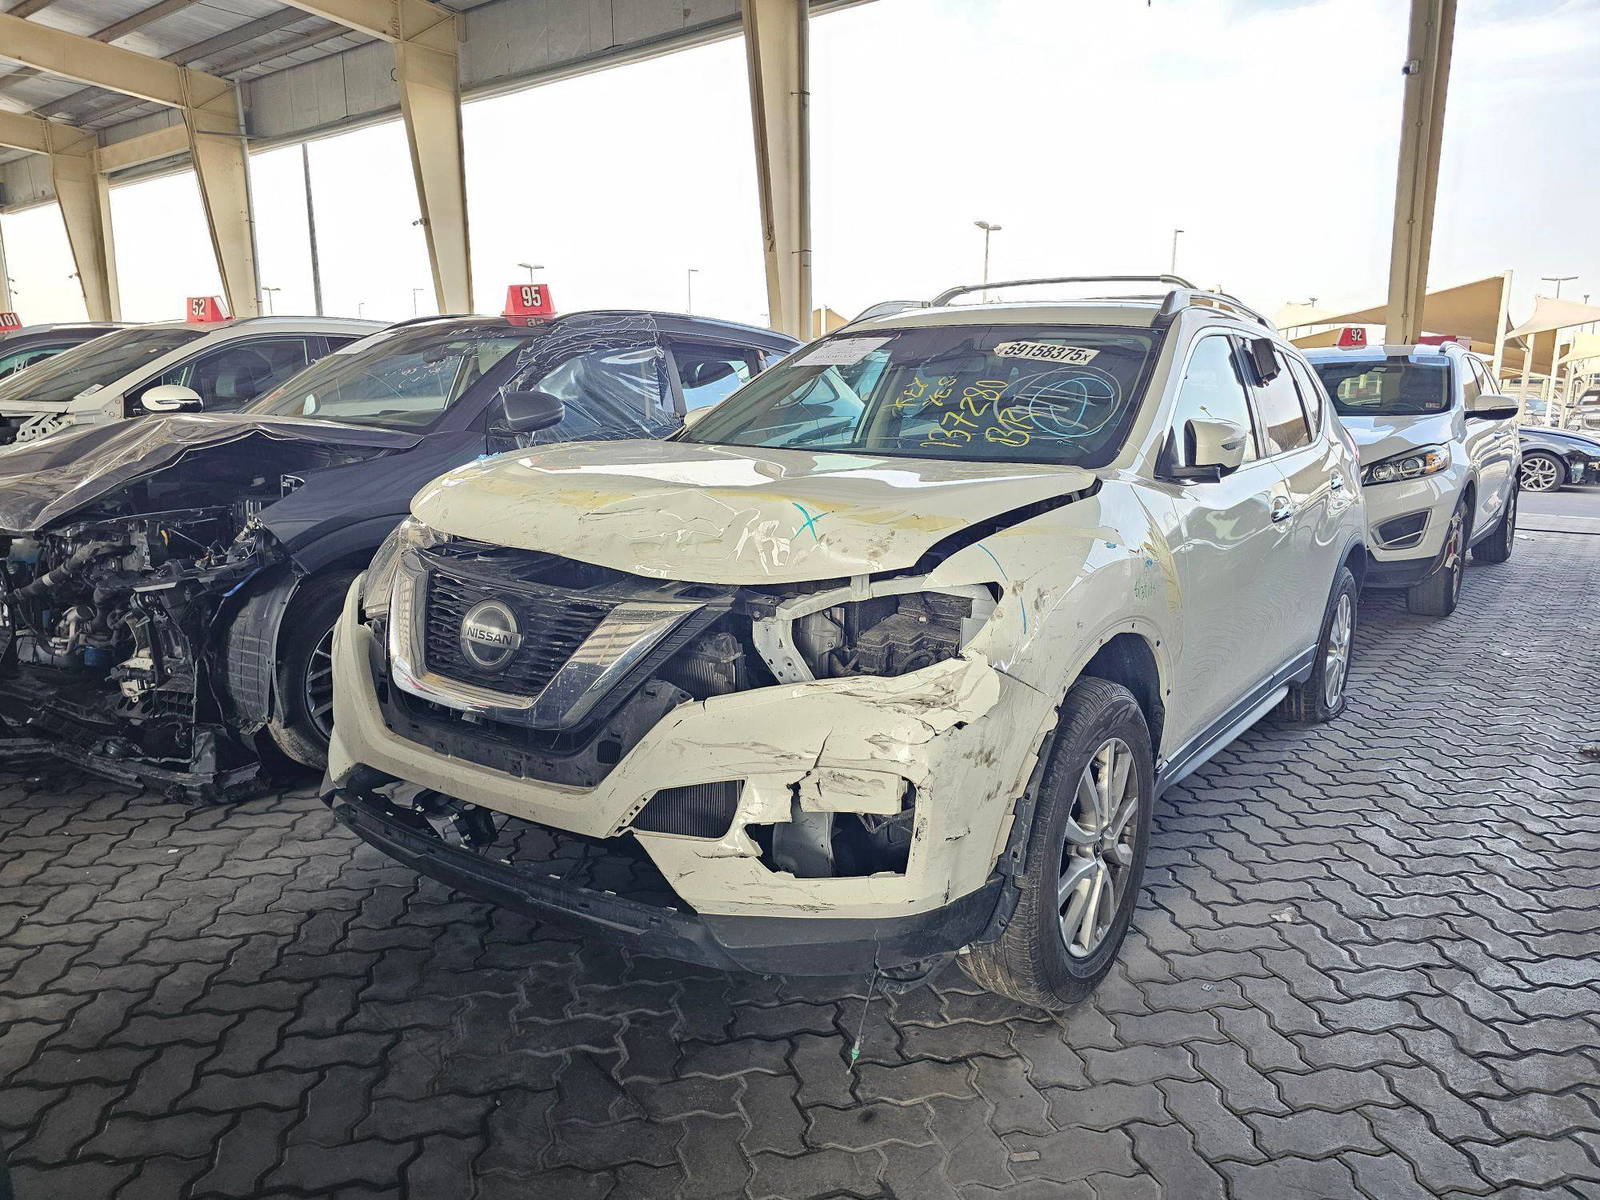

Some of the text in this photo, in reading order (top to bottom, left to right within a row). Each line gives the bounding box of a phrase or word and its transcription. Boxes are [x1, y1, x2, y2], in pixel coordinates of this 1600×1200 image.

[521, 286, 542, 307] 95
[192, 298, 206, 316] 52
[1351, 328, 1363, 341] 92
[467, 626, 512, 645] NISSAN
